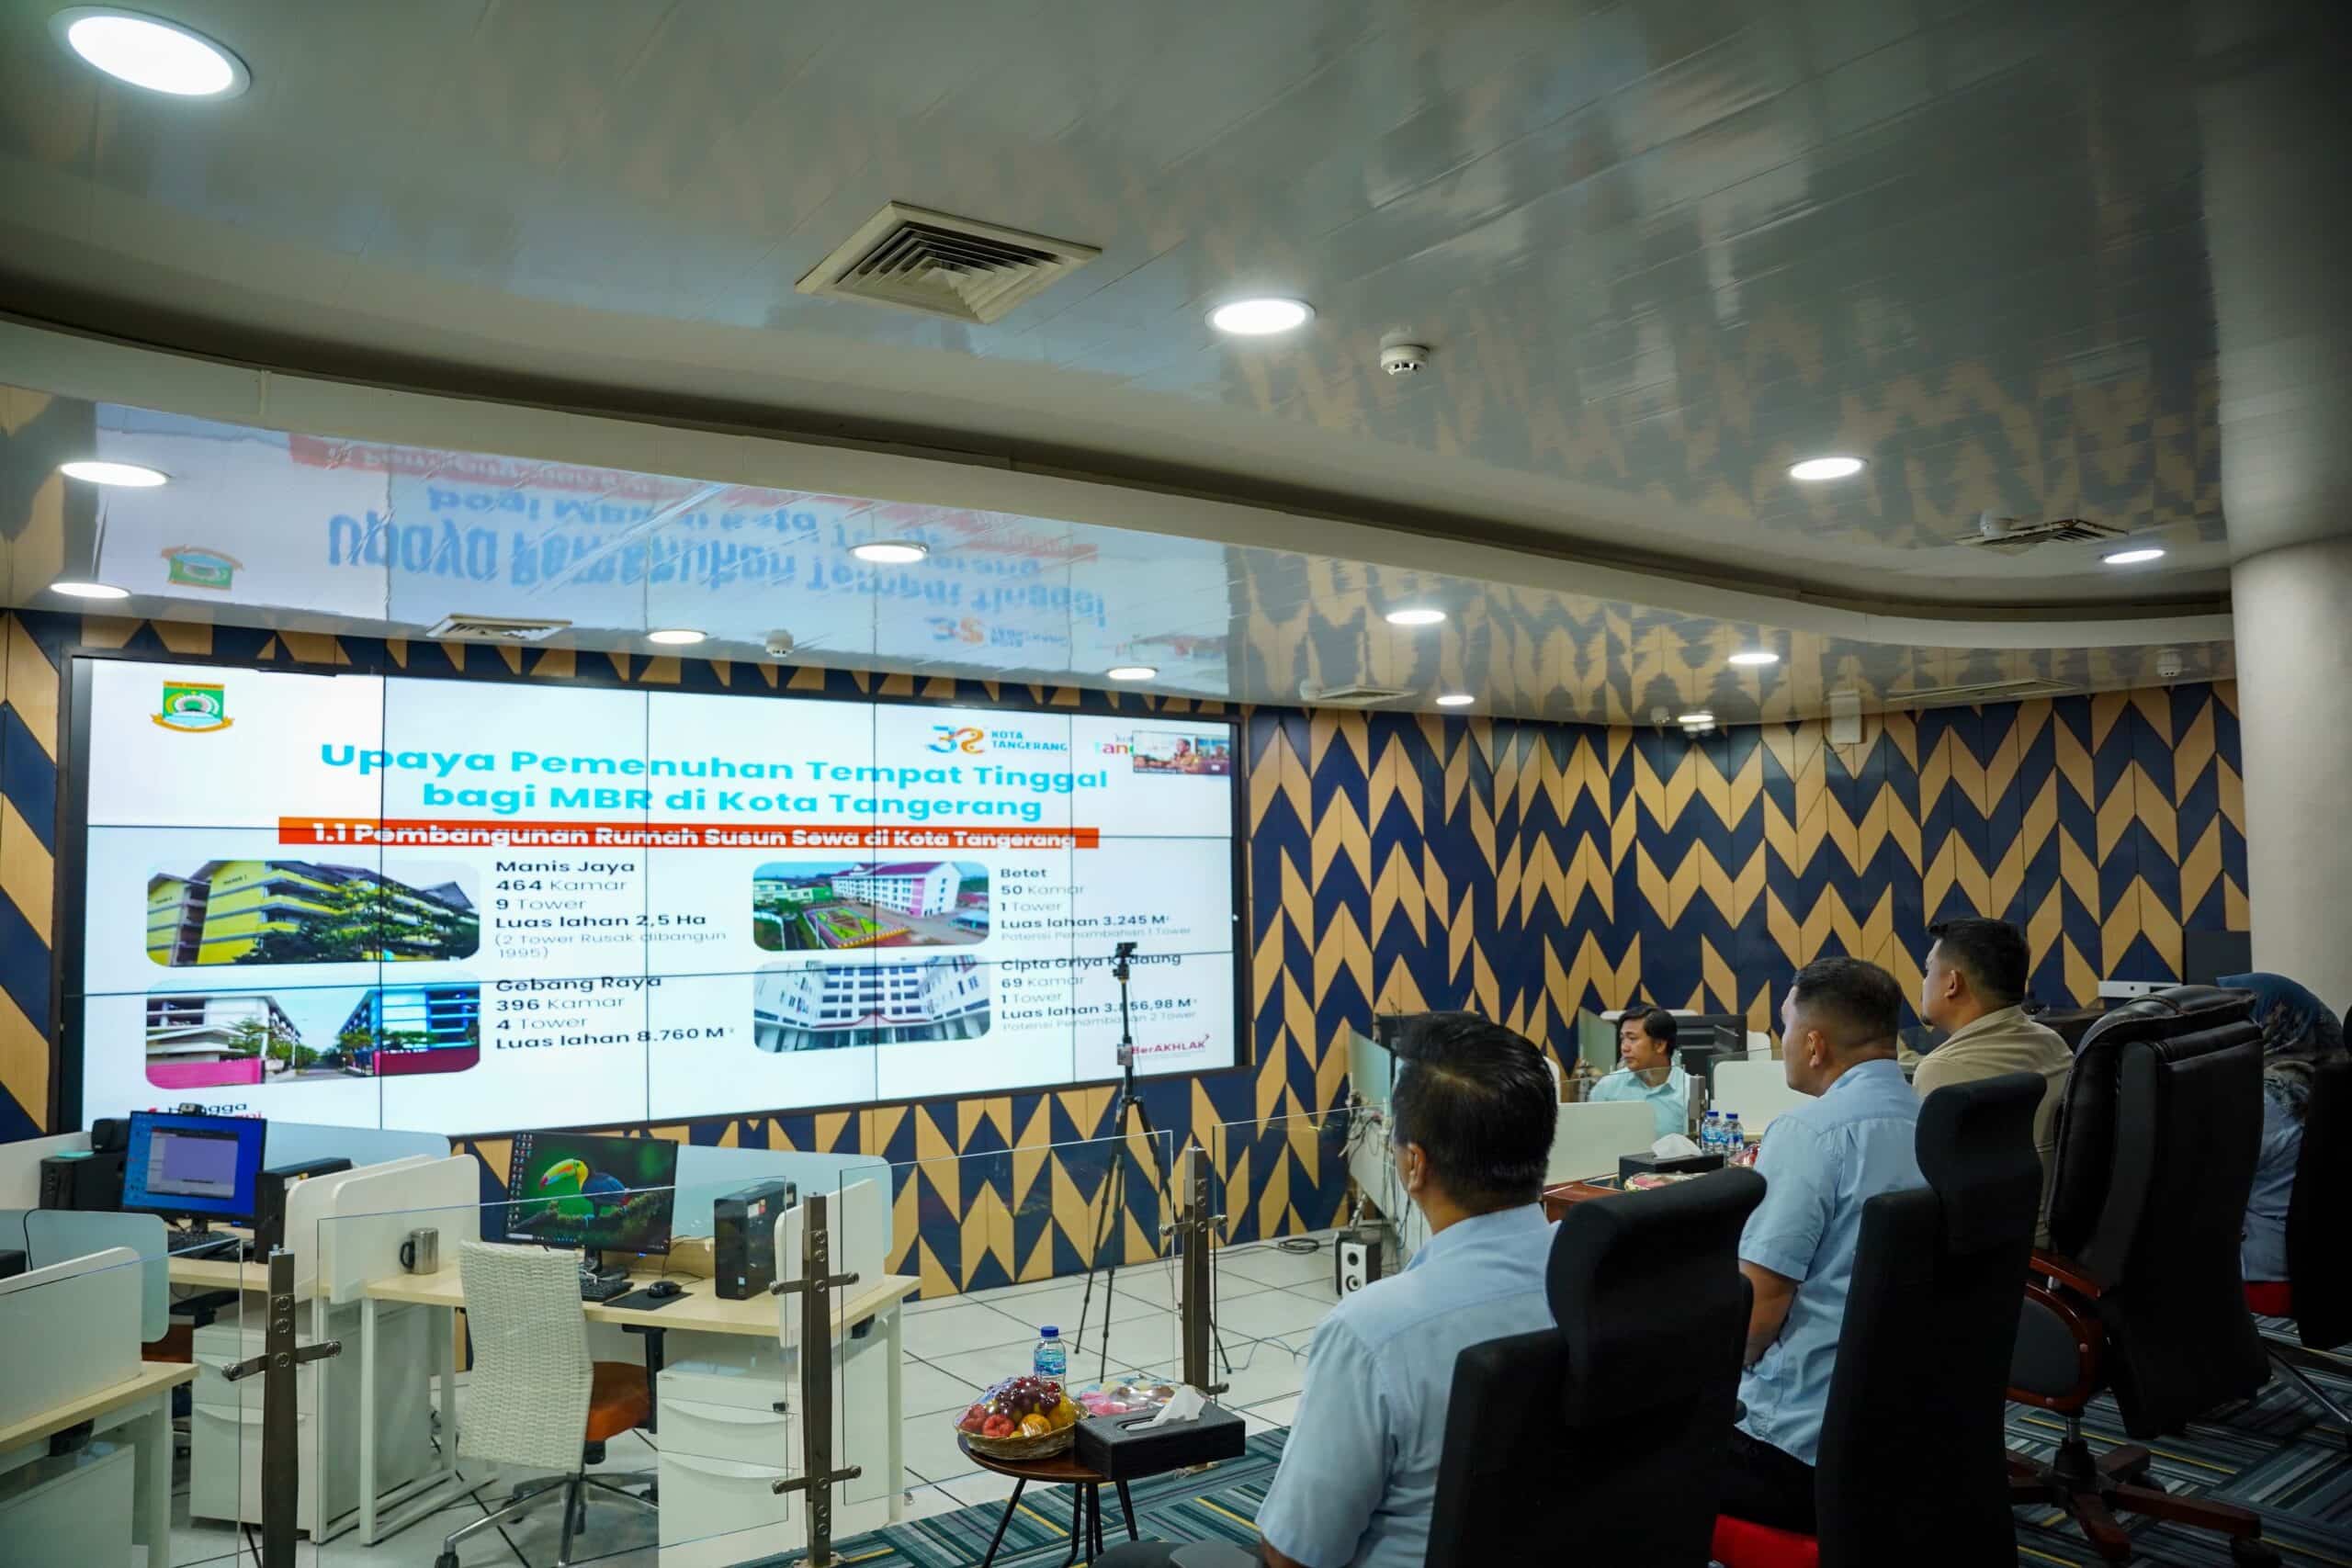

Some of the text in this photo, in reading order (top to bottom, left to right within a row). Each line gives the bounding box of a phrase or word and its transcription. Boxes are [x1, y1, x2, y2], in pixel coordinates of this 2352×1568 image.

[990, 730, 1023, 740] KOTA
[991, 741, 1068, 751] TANGERANG
[322, 744, 1107, 794] Upaya Pemenuhan Tempat Tinggal
[424, 784, 1042, 822] bagi MBR di Kota Tangerang
[312, 822, 1076, 849] 1.1 Pembangunan Rumah Susun Sewa di Kota Tangerang
[495, 861, 635, 874] Manis Jaya
[1001, 868, 1047, 878] Betet
[495, 880, 628, 891] 464 Kamar
[1001, 885, 1085, 896] 50 Kamar
[495, 898, 587, 909] 9 Tower
[1001, 901, 1063, 912] 1 Tower
[495, 915, 707, 929] Luas lahan 2,5 Ha
[1001, 919, 1043, 930] Luas
[1047, 918, 1099, 928] lahan
[1102, 915, 1148, 926] 3.245
[494, 931, 727, 946] (2 Tower Rusak dibangun
[1001, 953, 1182, 974] Cipta Griya Kdaung
[495, 976, 662, 993] Gebang Raya
[1001, 976, 1085, 989] 69 Kamar
[496, 997, 626, 1011] 396 Kamar
[1001, 994, 1063, 1004] 1 Tower
[1001, 1009, 1043, 1020] Luas
[1047, 1007, 1099, 1018] lahan
[495, 1017, 588, 1030] 4 Tower
[496, 1036, 551, 1049] Luas
[560, 1033, 629, 1045] lahan
[637, 1028, 699, 1042] 8.760
